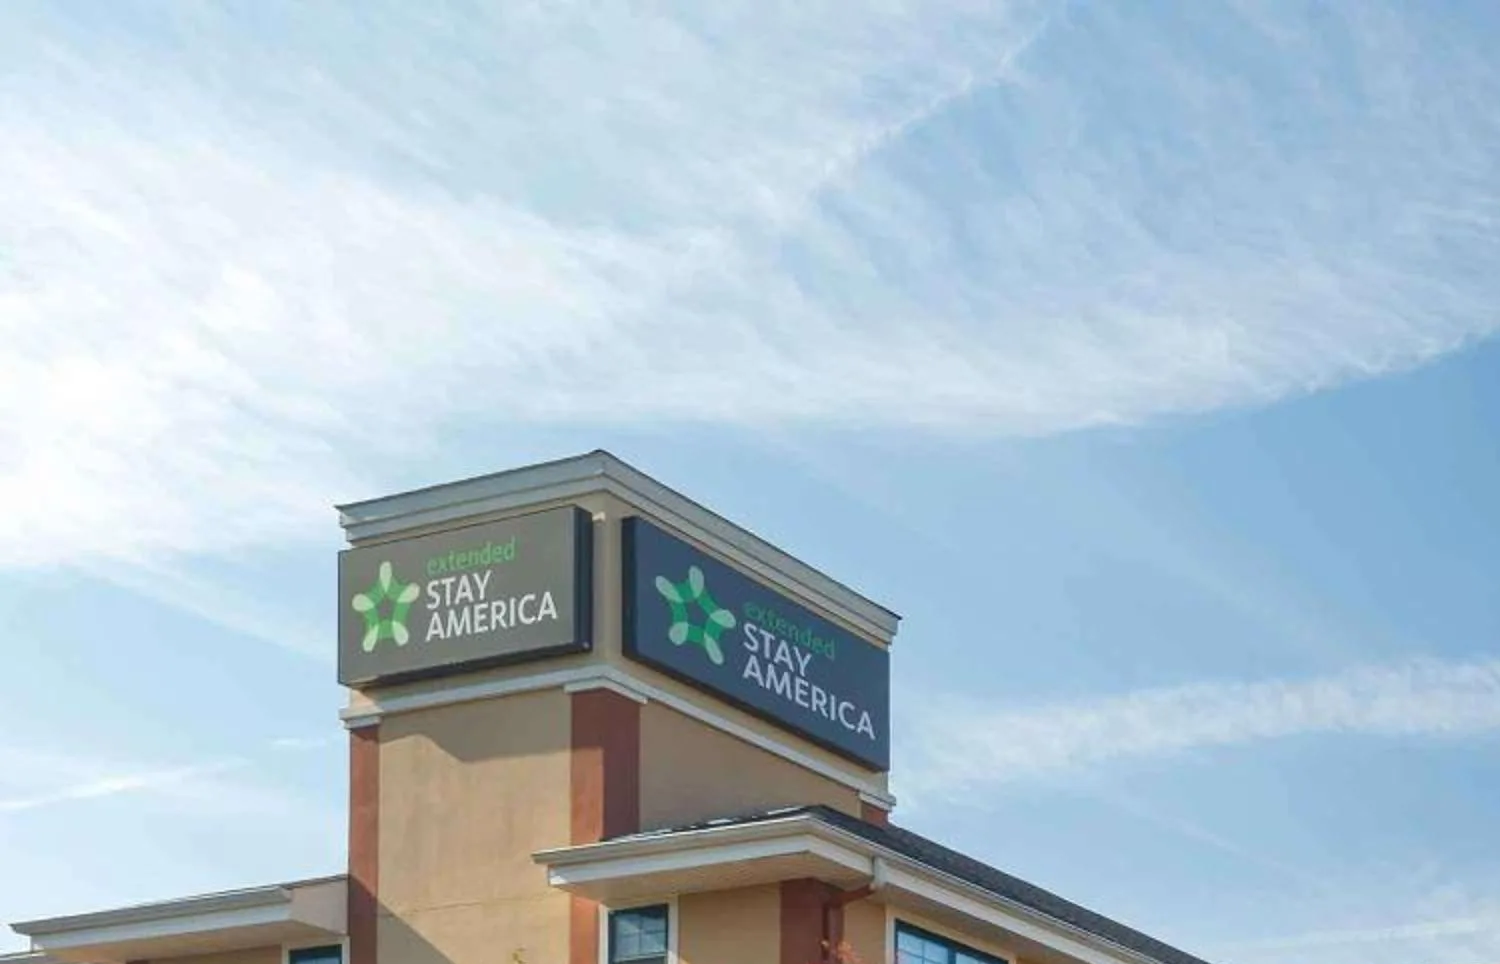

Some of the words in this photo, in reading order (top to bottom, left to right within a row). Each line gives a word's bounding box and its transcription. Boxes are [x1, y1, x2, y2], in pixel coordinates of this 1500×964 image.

[426, 536, 516, 577] extended
[426, 570, 491, 609] STAY
[425, 591, 557, 641] AMERICA
[744, 602, 835, 660] extended
[743, 622, 812, 677] STAY
[742, 655, 876, 740] AMERICA
